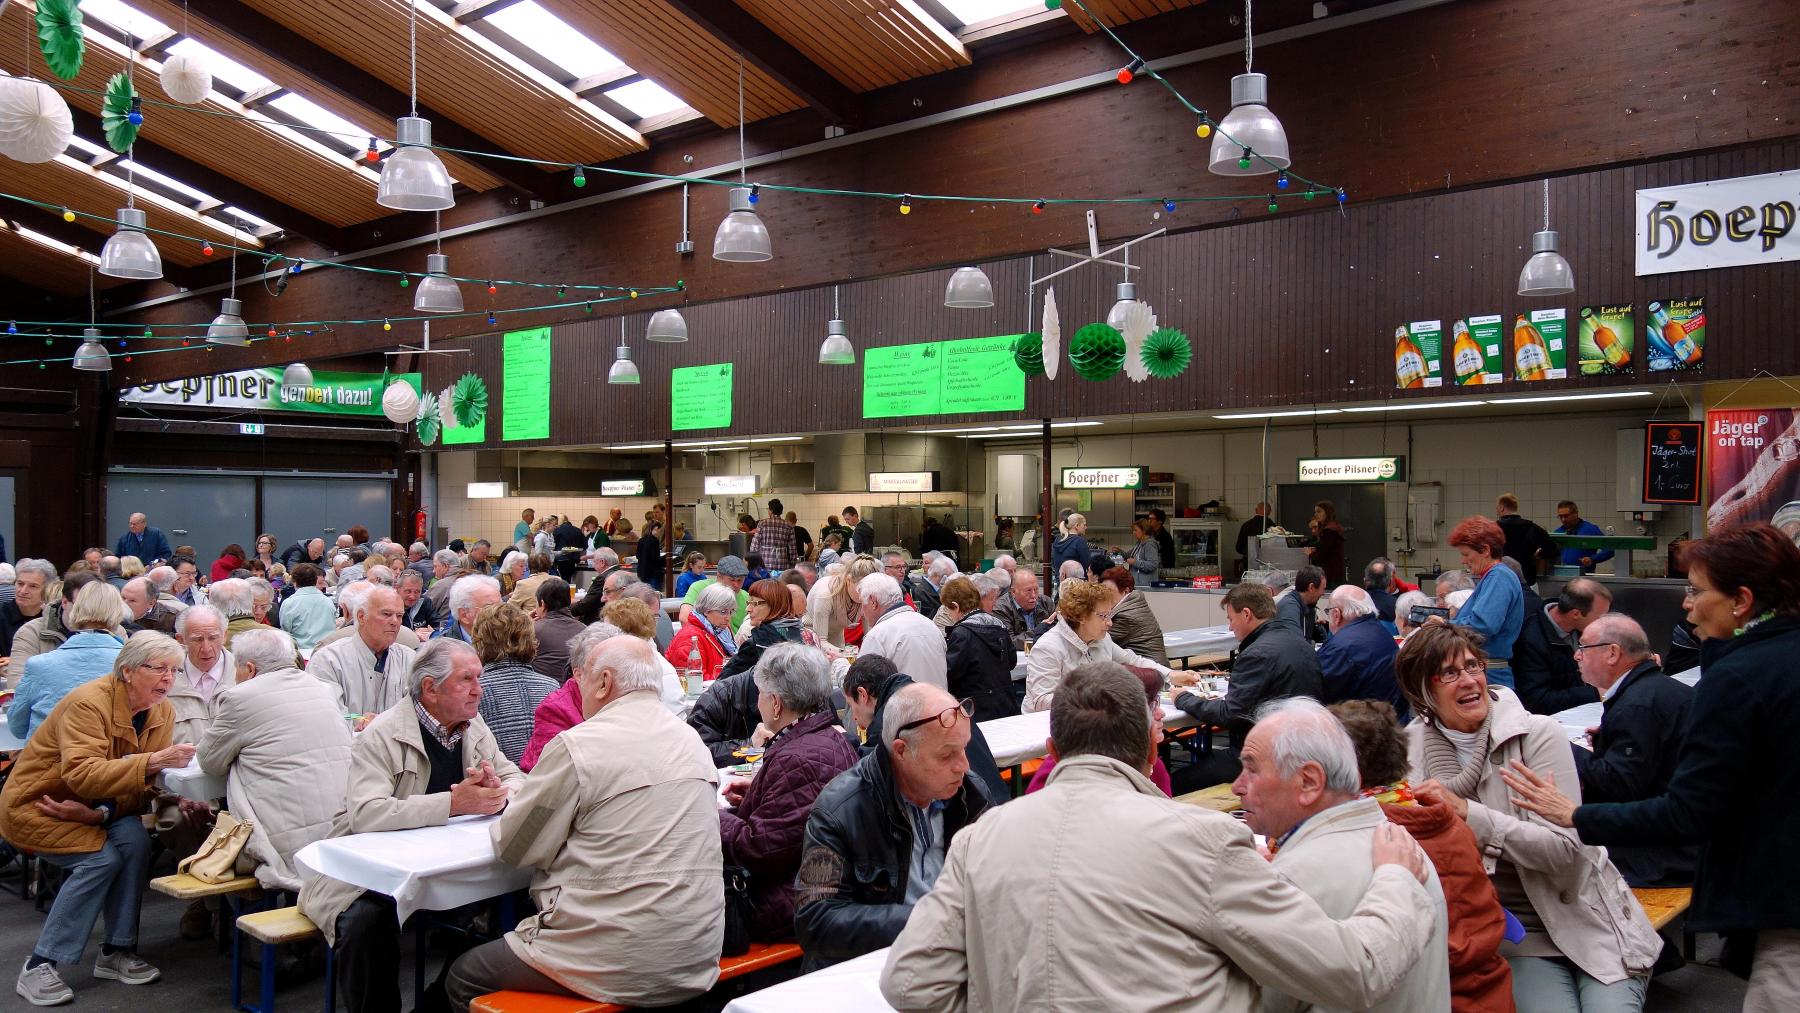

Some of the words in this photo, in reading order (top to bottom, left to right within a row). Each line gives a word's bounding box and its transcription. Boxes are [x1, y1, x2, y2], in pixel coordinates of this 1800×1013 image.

[1646, 192, 1800, 259] Hoep
[1601, 305, 1617, 314] Lust
[1618, 303, 1633, 313] auf
[1670, 299, 1687, 308] Lust
[1689, 297, 1704, 307] auf
[336, 386, 372, 406] dazu!
[1712, 419, 1760, 438] Jäger
[1718, 437, 1736, 447] on
[1740, 436, 1764, 449] tap
[1302, 465, 1341, 476] Hoepfner
[1344, 464, 1377, 474] Pilsner
[1068, 471, 1120, 486] Hoepfner
